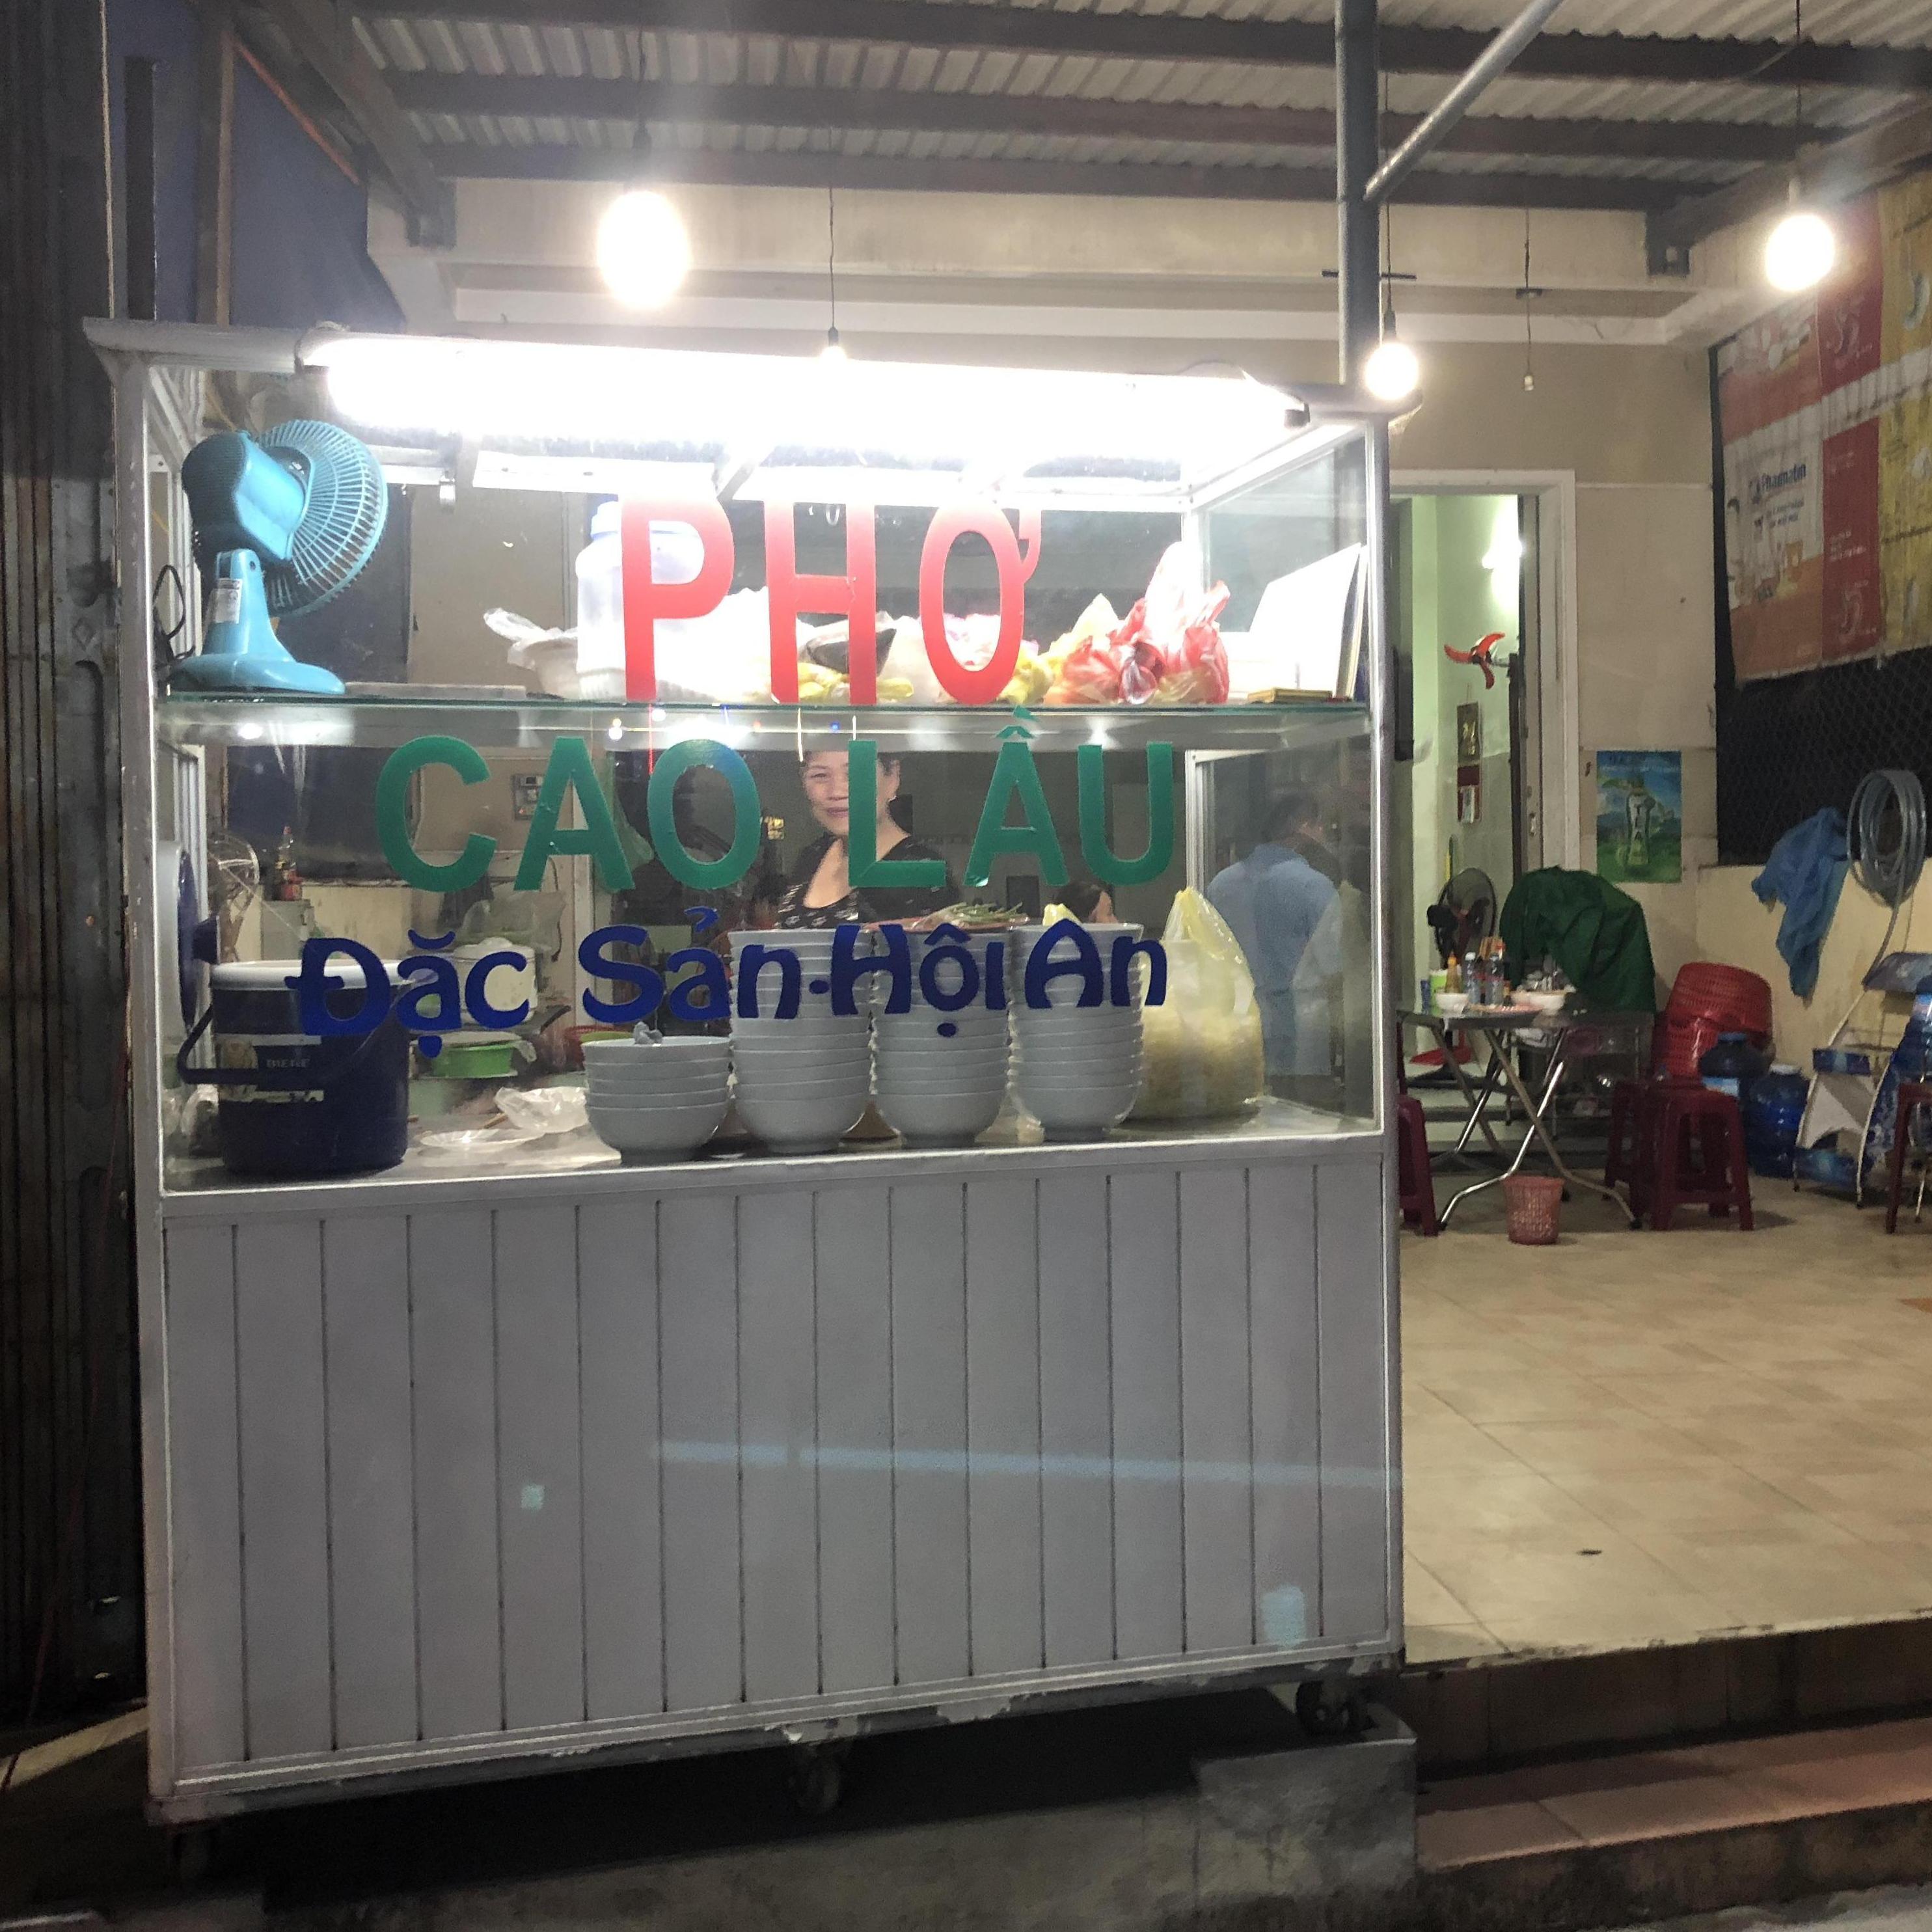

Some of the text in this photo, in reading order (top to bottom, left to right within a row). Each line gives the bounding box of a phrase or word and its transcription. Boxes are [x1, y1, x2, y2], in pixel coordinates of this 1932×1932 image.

[375, 735, 761, 893] CAO
[284, 929, 532, 1058] Đặc
[1024, 918, 1167, 1009] An
